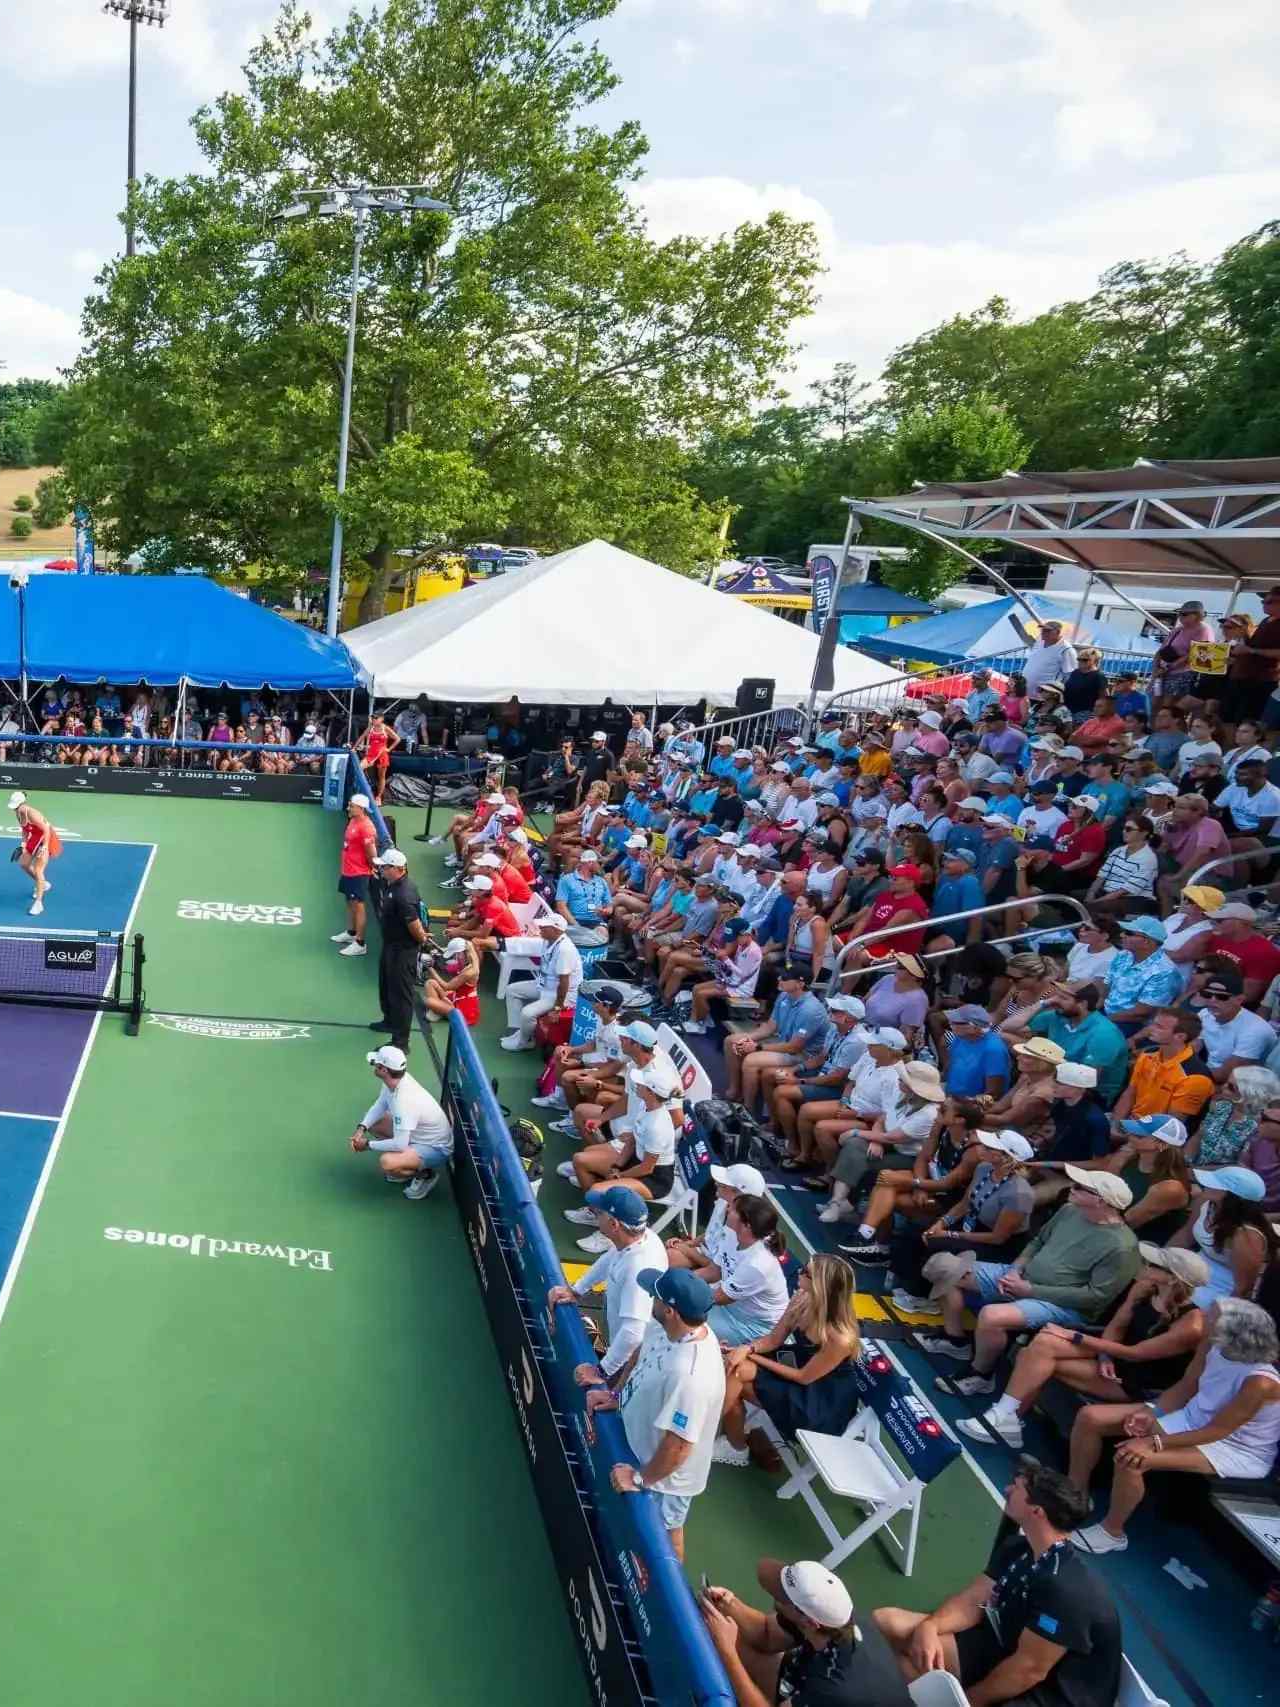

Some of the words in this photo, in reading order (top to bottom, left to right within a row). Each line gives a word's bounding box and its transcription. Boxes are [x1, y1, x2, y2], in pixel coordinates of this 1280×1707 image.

[178, 772, 213, 780] LOUIS
[176, 909, 303, 926] GRAND
[178, 899, 303, 917] RAPIDS
[103, 1226, 334, 1272] EdwardJones
[885, 1411, 916, 1456] RESERVED
[897, 1409, 927, 1450] DOORDASH
